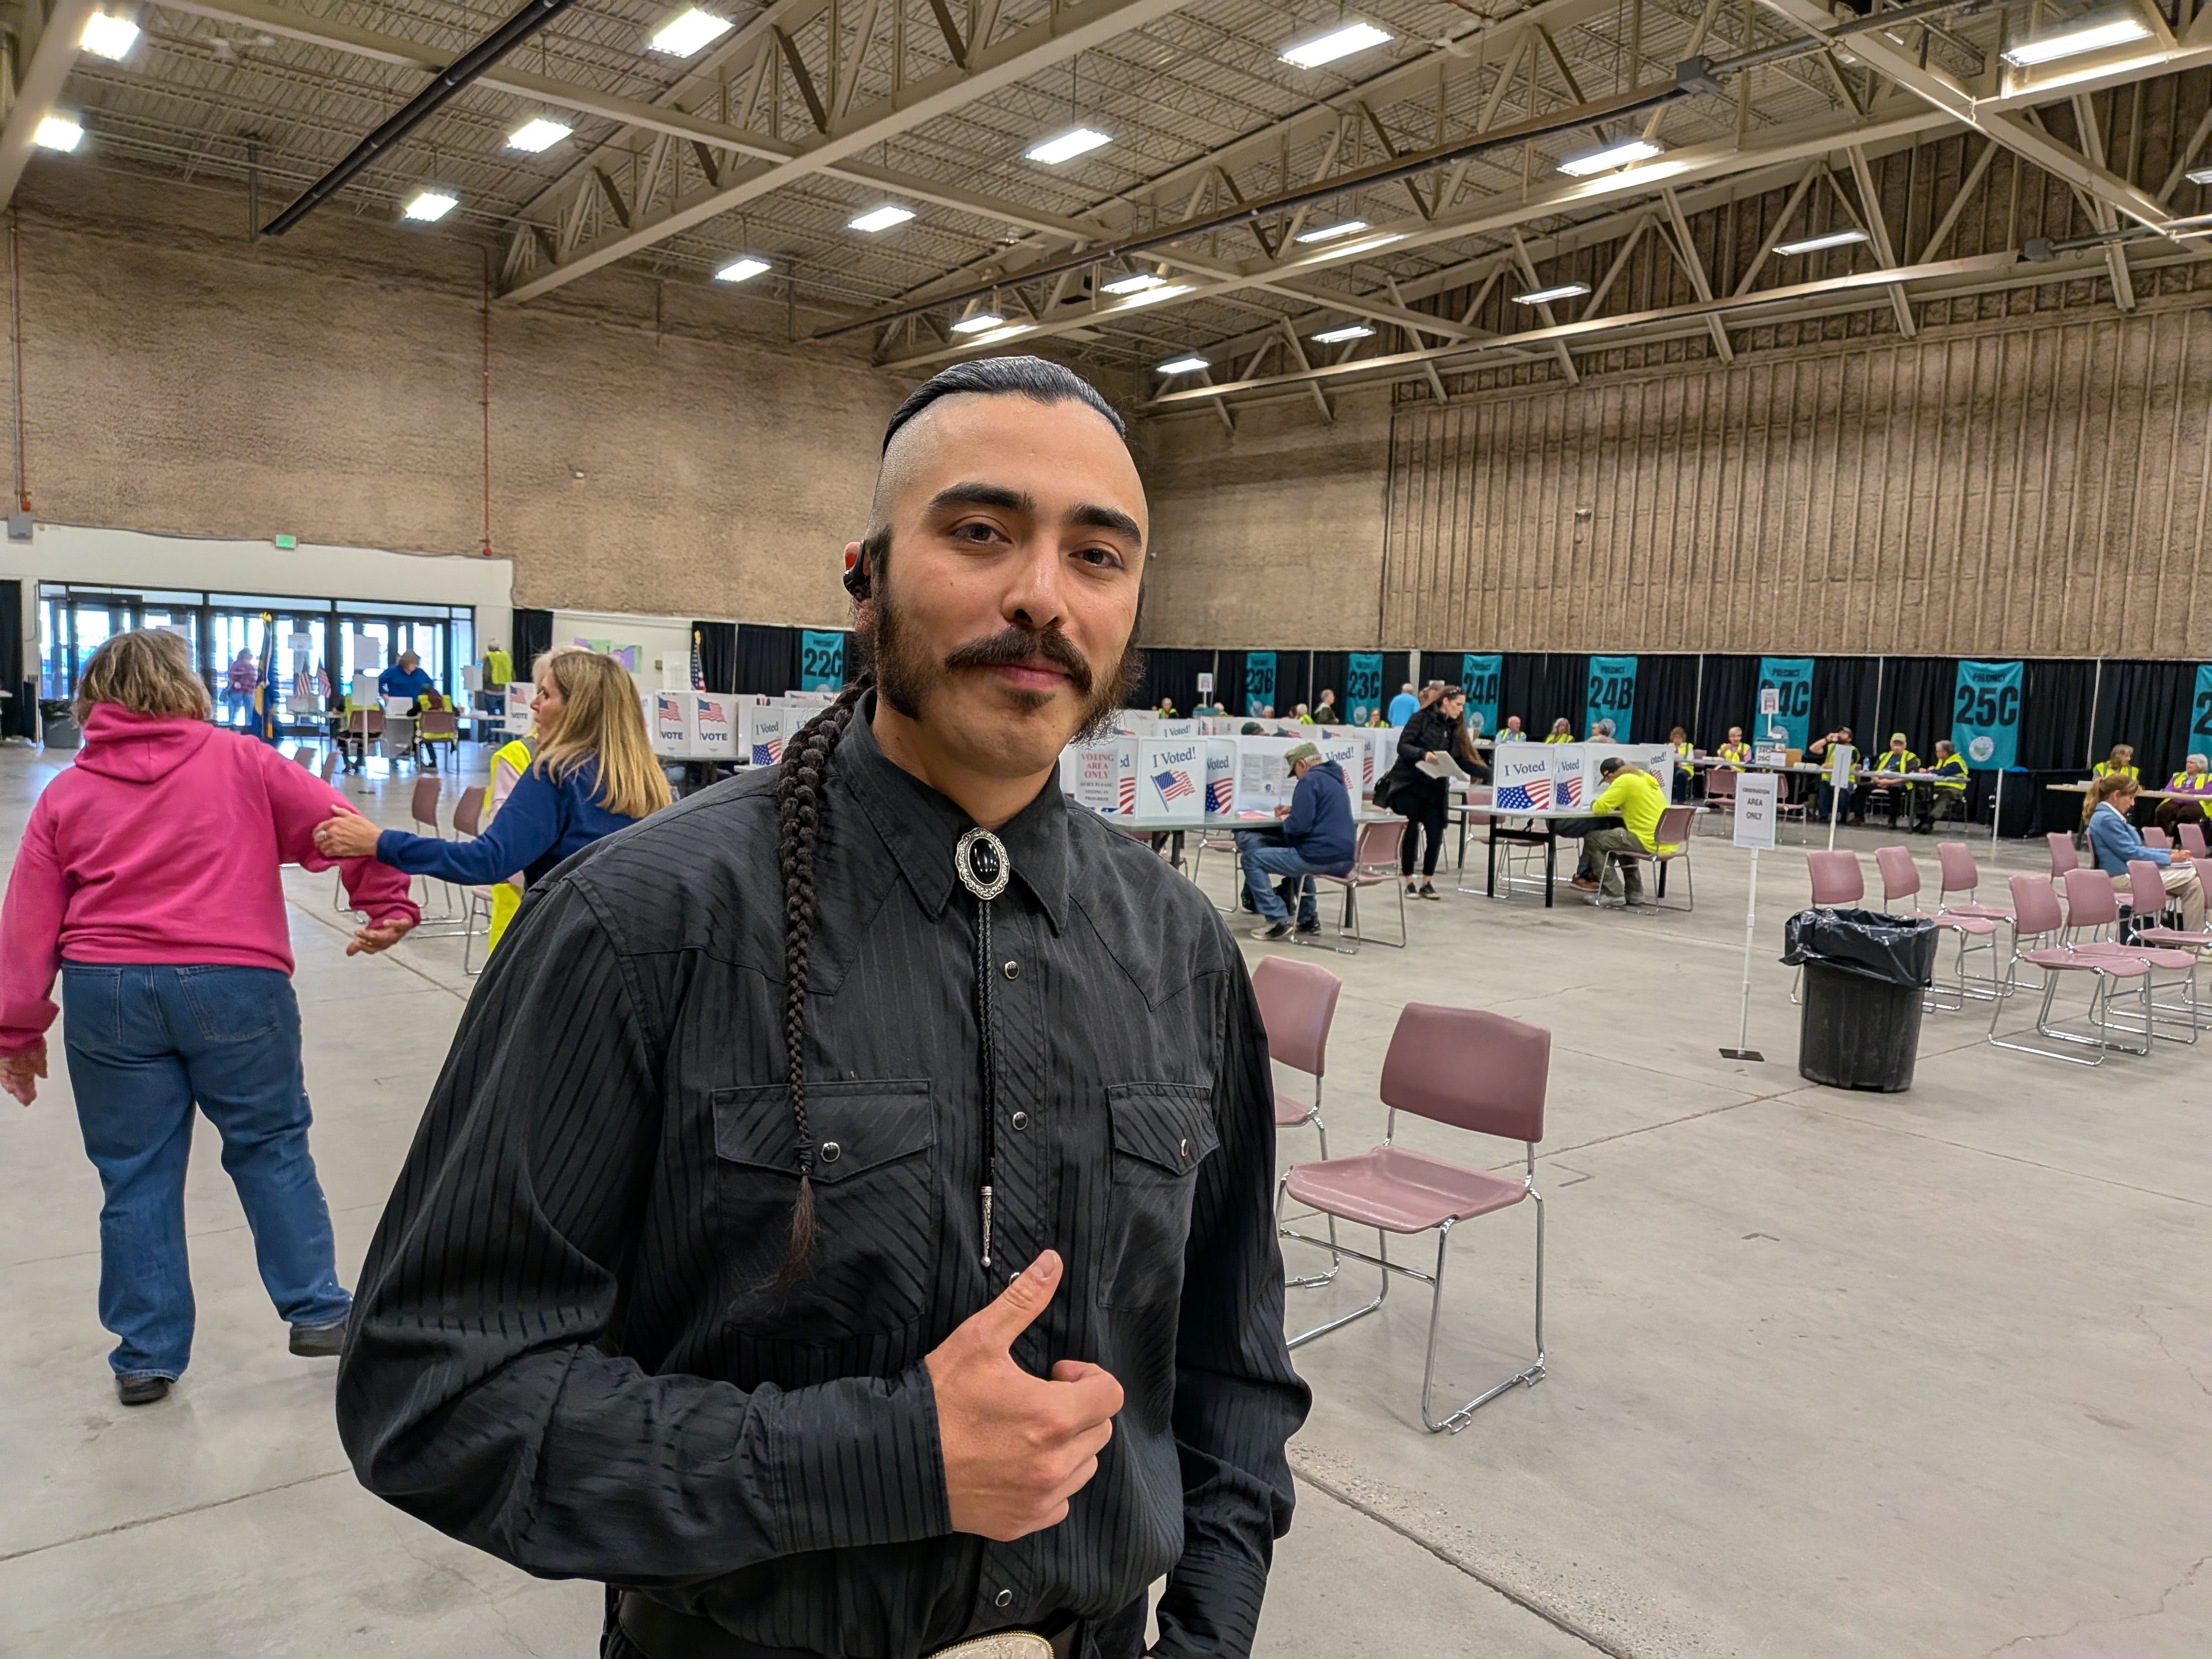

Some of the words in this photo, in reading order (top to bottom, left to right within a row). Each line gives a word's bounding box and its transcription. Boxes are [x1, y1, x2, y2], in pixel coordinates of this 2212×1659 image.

[804, 648, 842, 677] 22C
[1348, 670, 1380, 700] 23C
[1589, 676, 1635, 710] 24B
[1955, 685, 2018, 727] 25C
[756, 725, 759, 735] I
[760, 721, 779, 734] Voted
[1169, 724, 1191, 736] Voted!
[660, 731, 684, 740] VOTE
[701, 733, 728, 741] VOTE
[1152, 754, 1158, 768] I
[1160, 746, 1196, 765] Voted!
[1326, 747, 1354, 761] Voted!
[1650, 751, 1667, 764] oted!
[1207, 755, 1229, 770] Voted
[1504, 765, 1510, 776] I
[1512, 760, 1546, 775] Voted
[1561, 759, 1580, 771] Voted
[1746, 811, 1763, 820] ONLY
